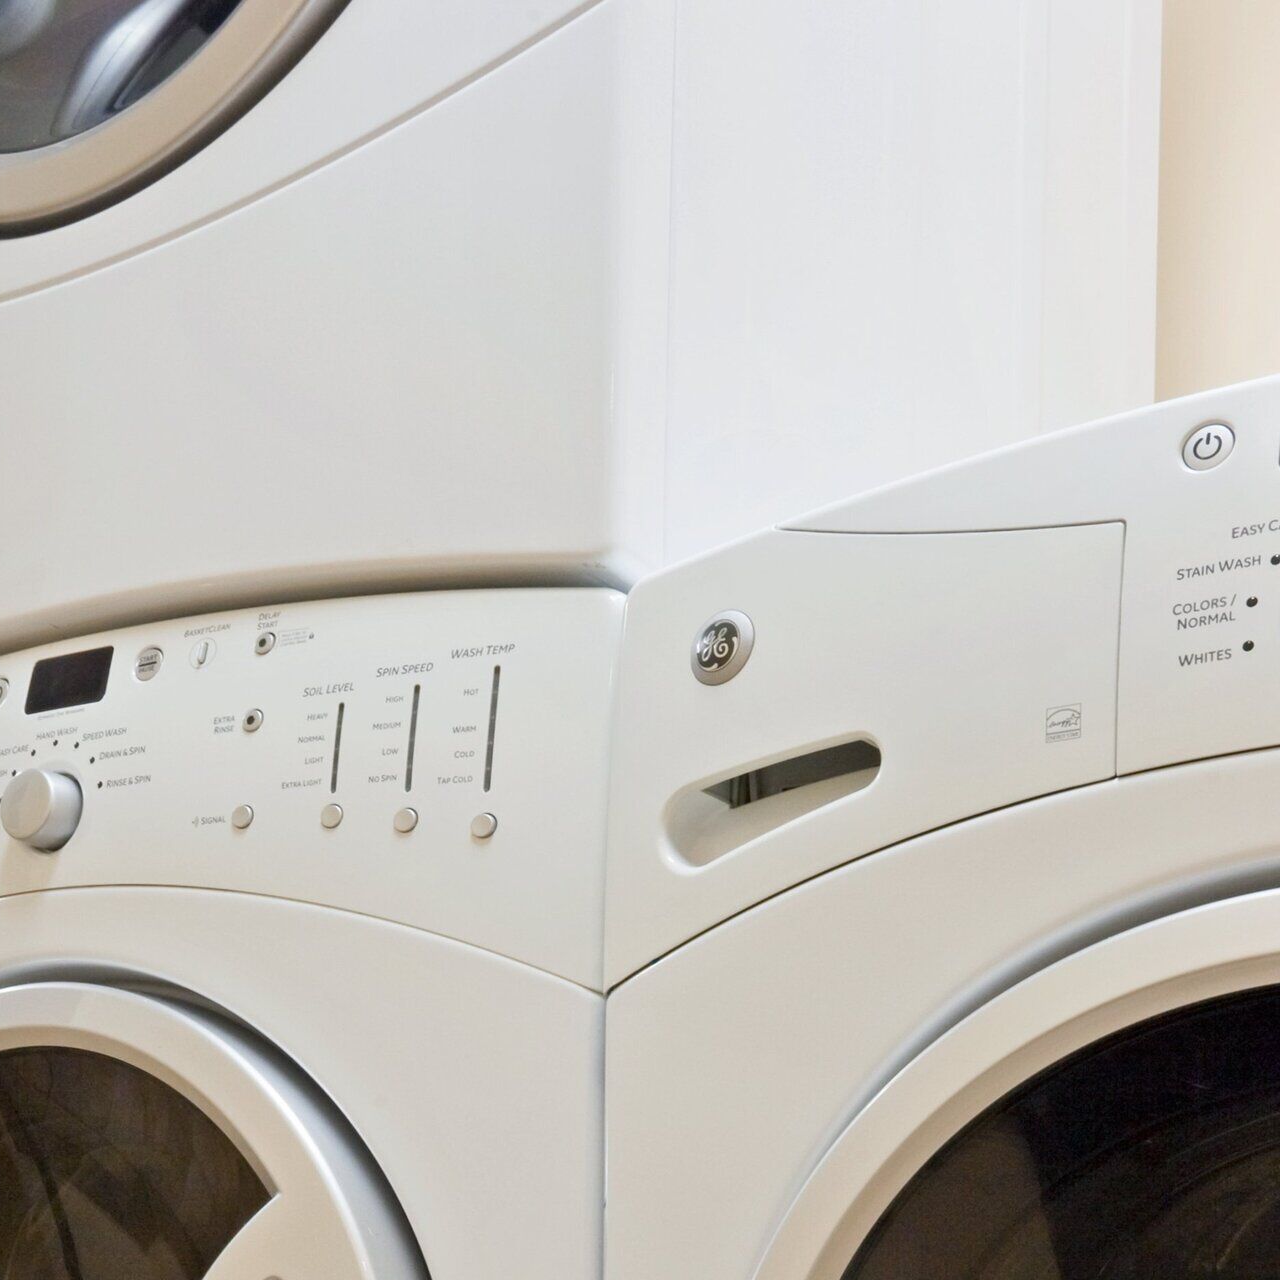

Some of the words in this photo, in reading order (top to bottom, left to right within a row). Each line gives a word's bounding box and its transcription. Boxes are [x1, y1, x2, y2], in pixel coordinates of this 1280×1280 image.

[1232, 523, 1265, 539] EASY
[1177, 564, 1215, 580] STAIN
[1218, 555, 1262, 572] WASH
[1172, 597, 1227, 616] COLORS
[1177, 611, 1236, 630] NORMAL
[139, 654, 159, 663] START
[451, 648, 483, 659] WASH
[486, 644, 516, 655] TEMP
[1178, 649, 1232, 667] WHITES
[376, 667, 399, 678] SPIN
[401, 663, 434, 675] SPEED
[303, 688, 324, 698] SOIL
[326, 683, 355, 694] LEVEL
[82, 731, 105, 742] SPEED
[105, 727, 128, 737] WASH
[452, 726, 477, 734] WARM
[99, 750, 121, 760] DRAIN
[130, 746, 147, 756] SPIN
[382, 748, 399, 756] LOW
[454, 751, 475, 759] COLD
[304, 757, 324, 765] LIGHT
[107, 780, 127, 789] RINSE
[134, 775, 152, 784] SPIN
[437, 777, 451, 785] TAP
[453, 776, 473, 784] COLD
[201, 816, 226, 826] SIGNAL
